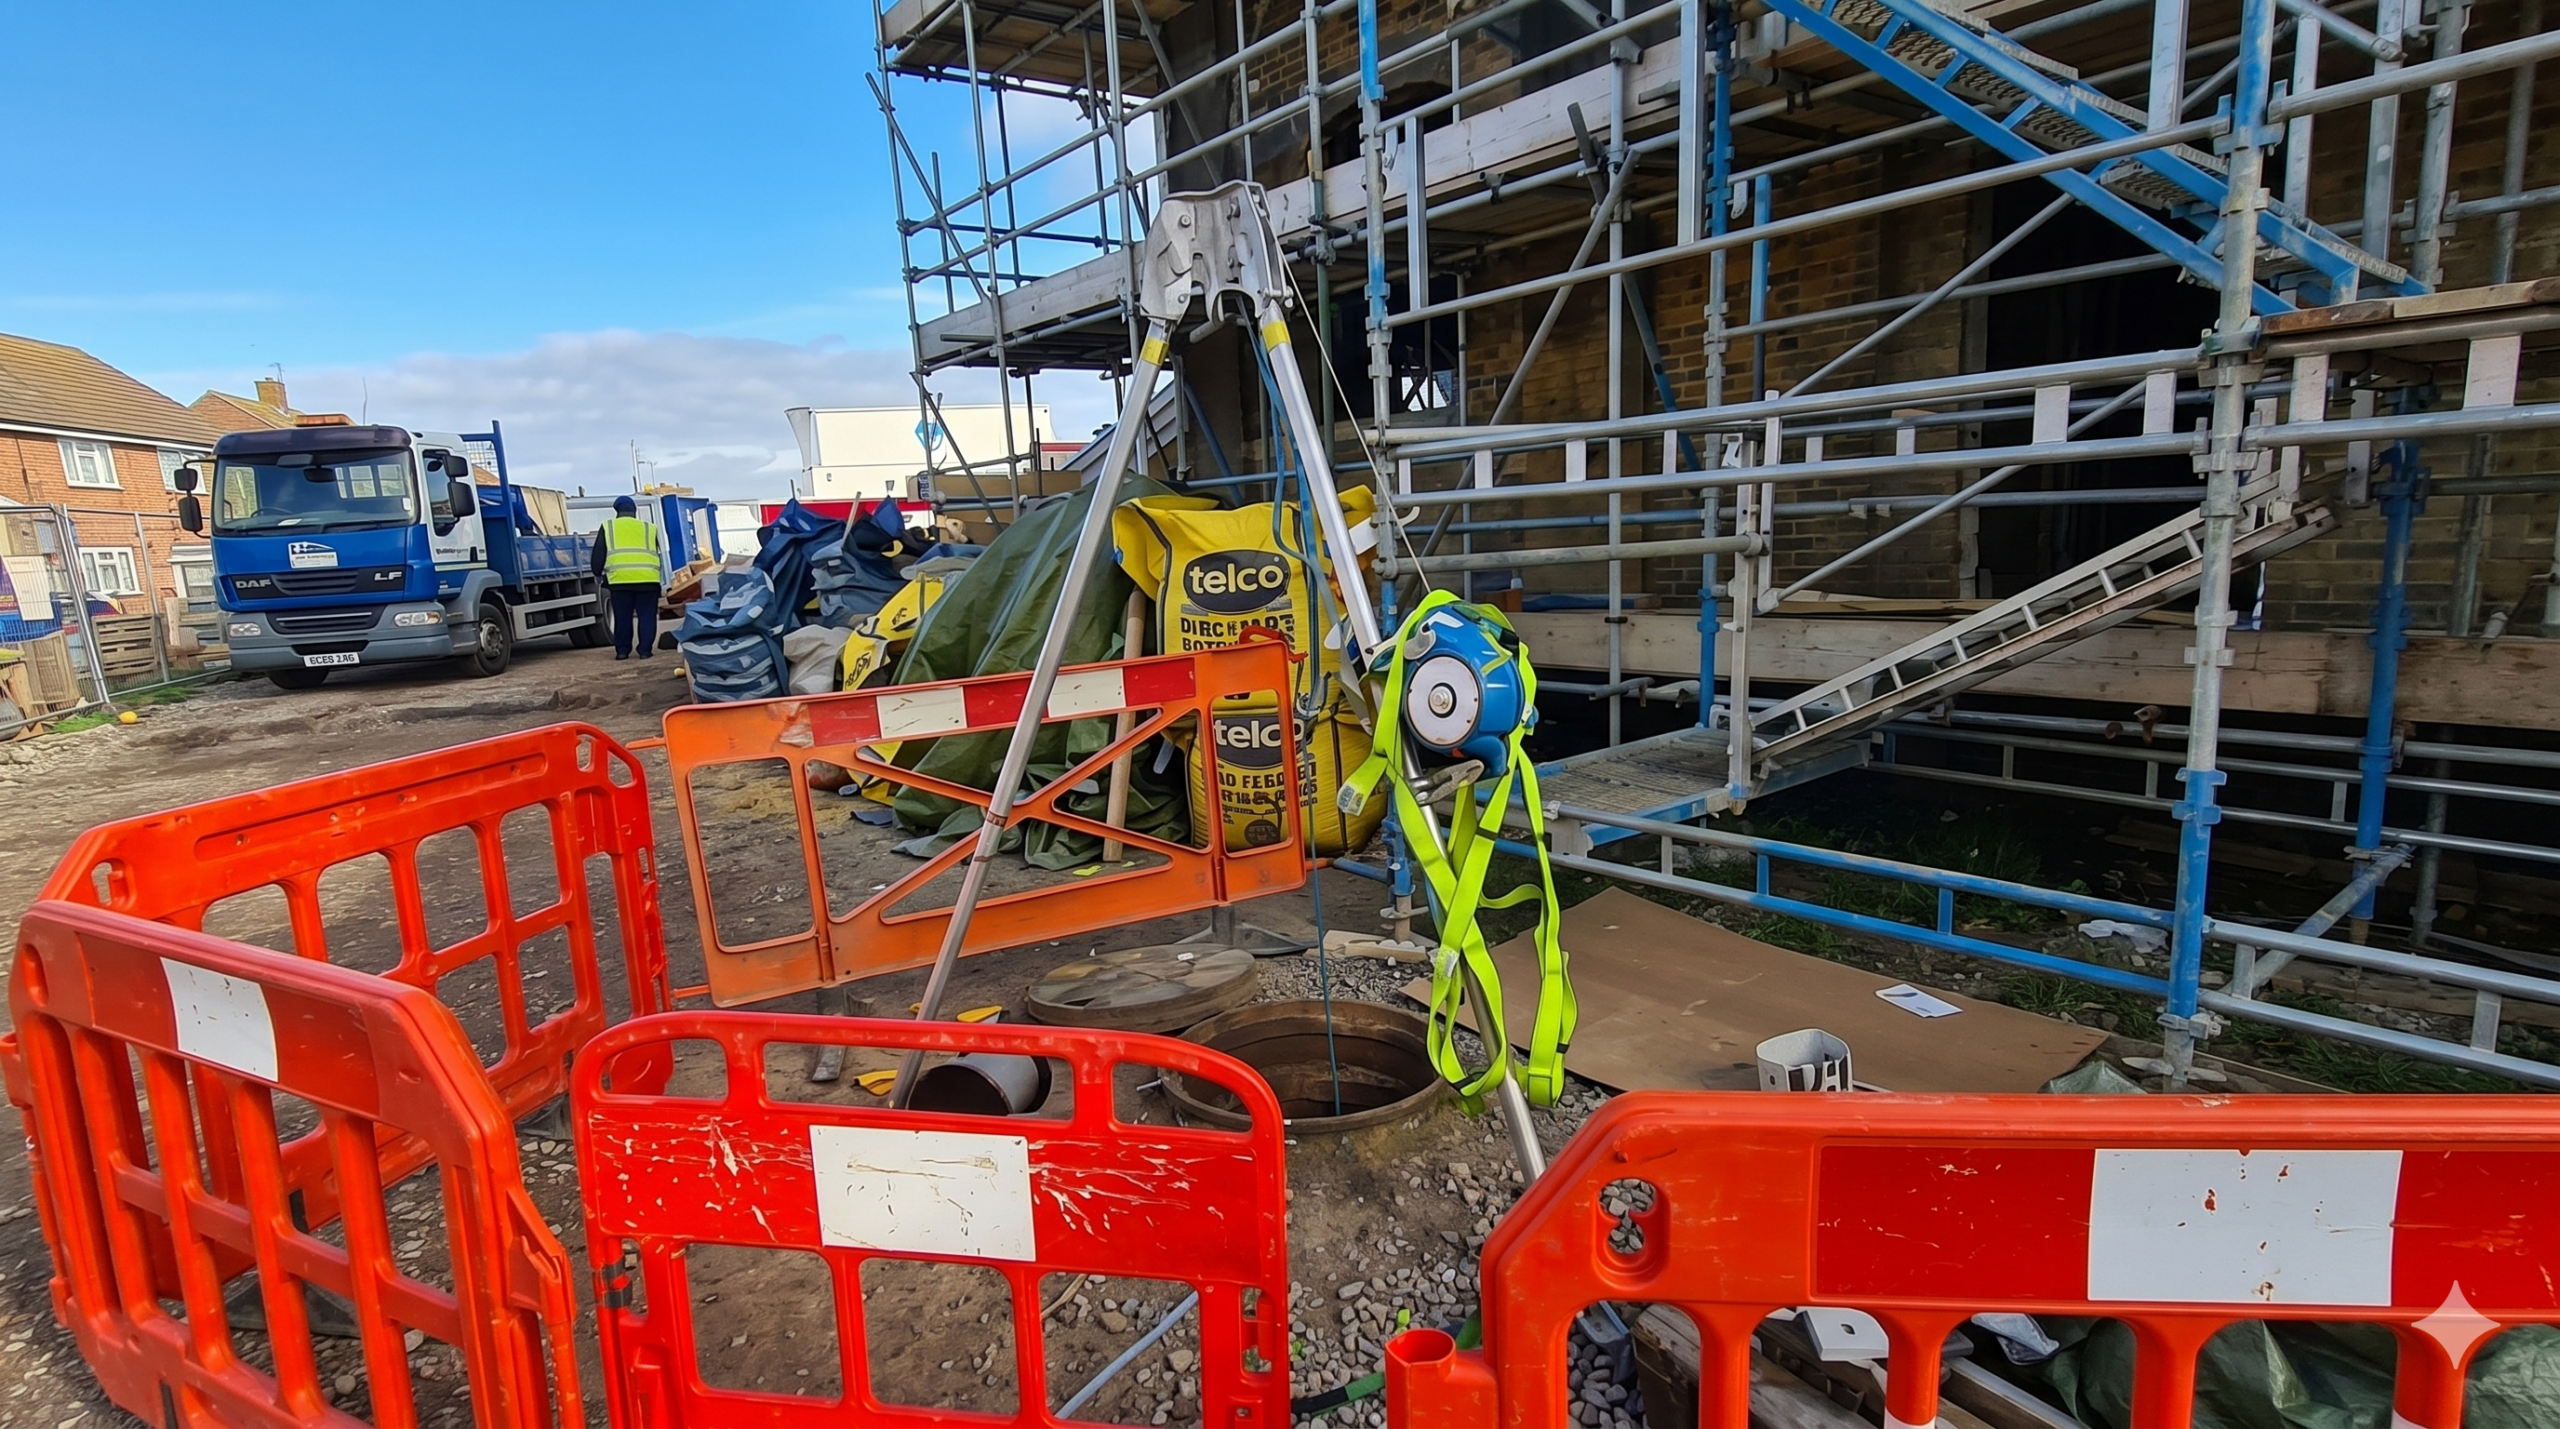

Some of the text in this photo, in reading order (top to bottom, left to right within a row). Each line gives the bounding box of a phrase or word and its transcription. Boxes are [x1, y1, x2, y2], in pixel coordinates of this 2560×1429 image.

[374, 571, 402, 581] LF
[1189, 562, 1284, 595] telco
[235, 579, 272, 589] DAF
